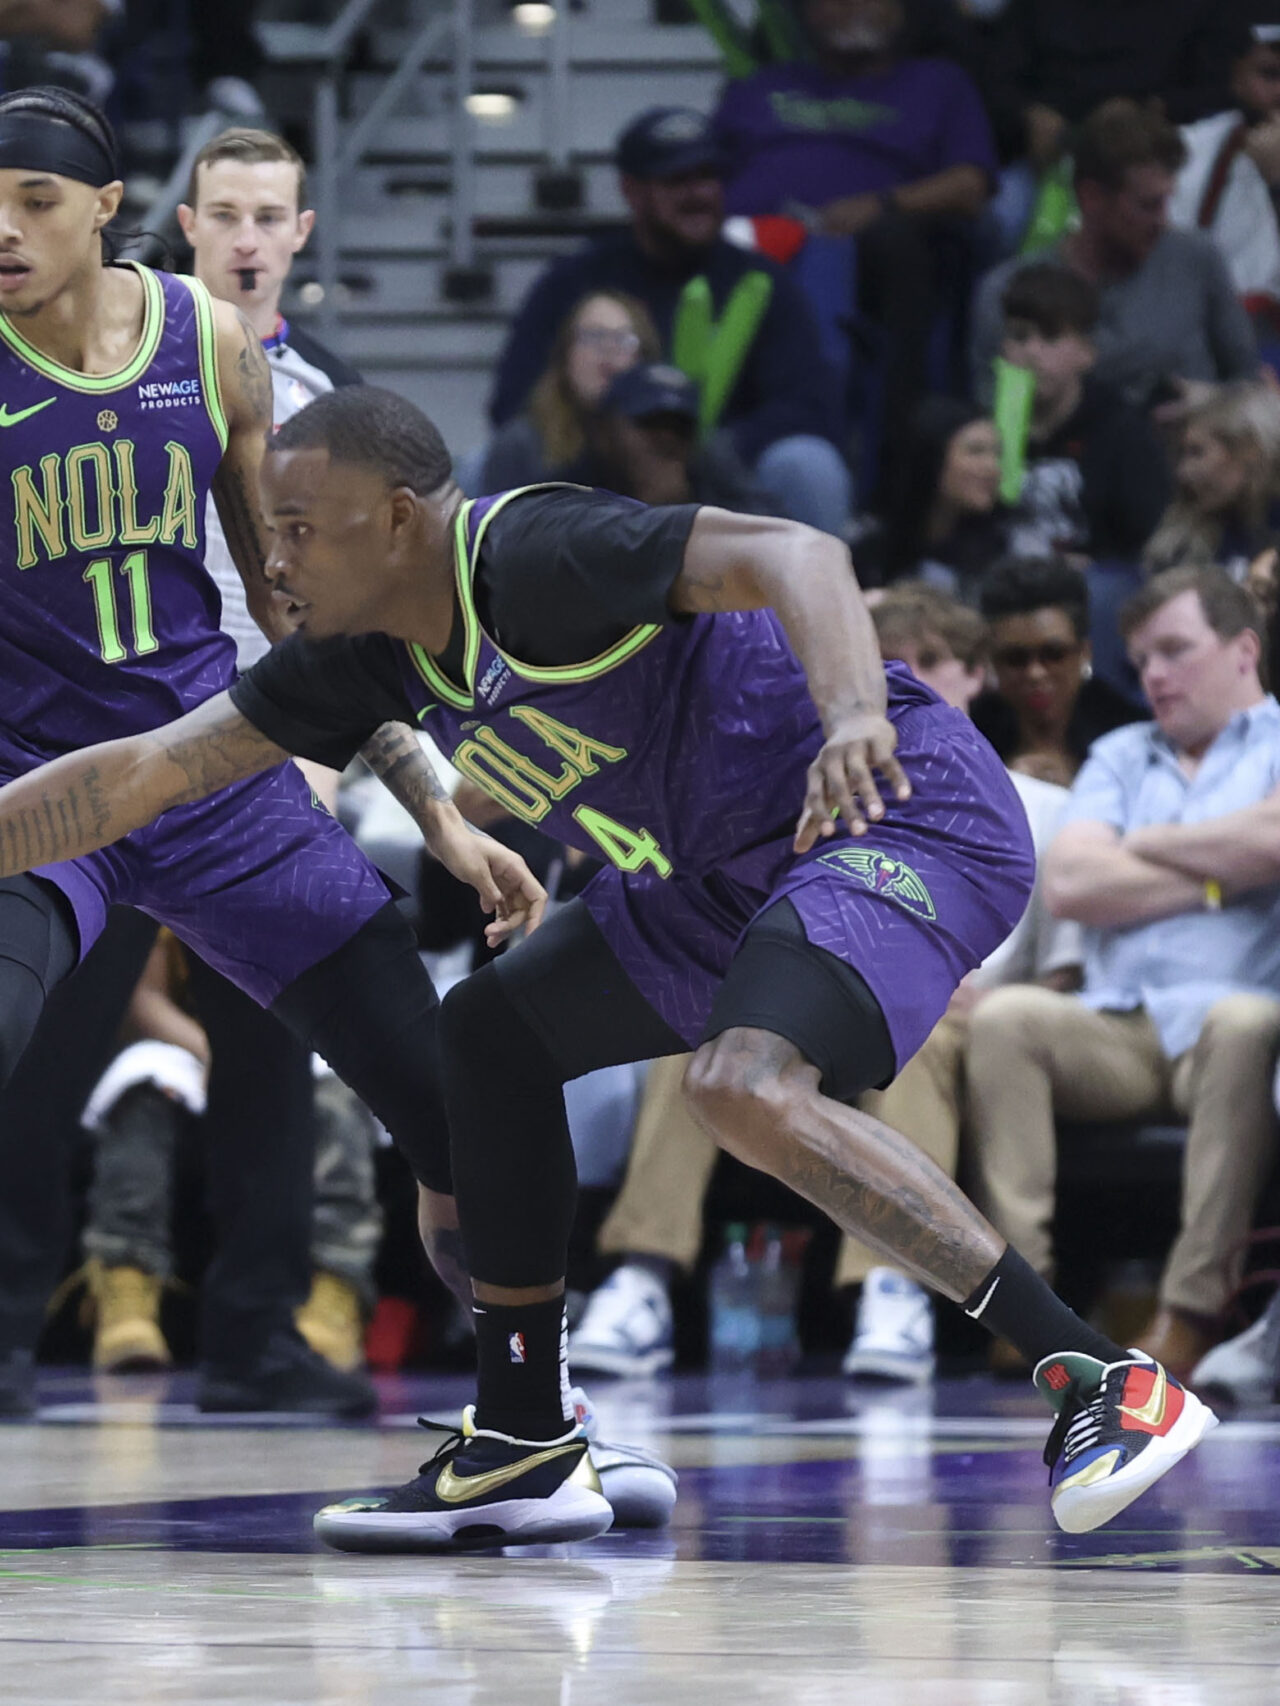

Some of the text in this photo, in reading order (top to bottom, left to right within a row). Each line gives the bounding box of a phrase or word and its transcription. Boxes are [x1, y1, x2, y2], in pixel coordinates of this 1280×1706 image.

[139, 379, 199, 398] NEWAGE
[140, 396, 201, 410] PRODUCTS
[11, 439, 198, 570] NOLA
[82, 549, 159, 664] 11
[452, 705, 628, 829] OLA
[572, 803, 674, 880] 4
